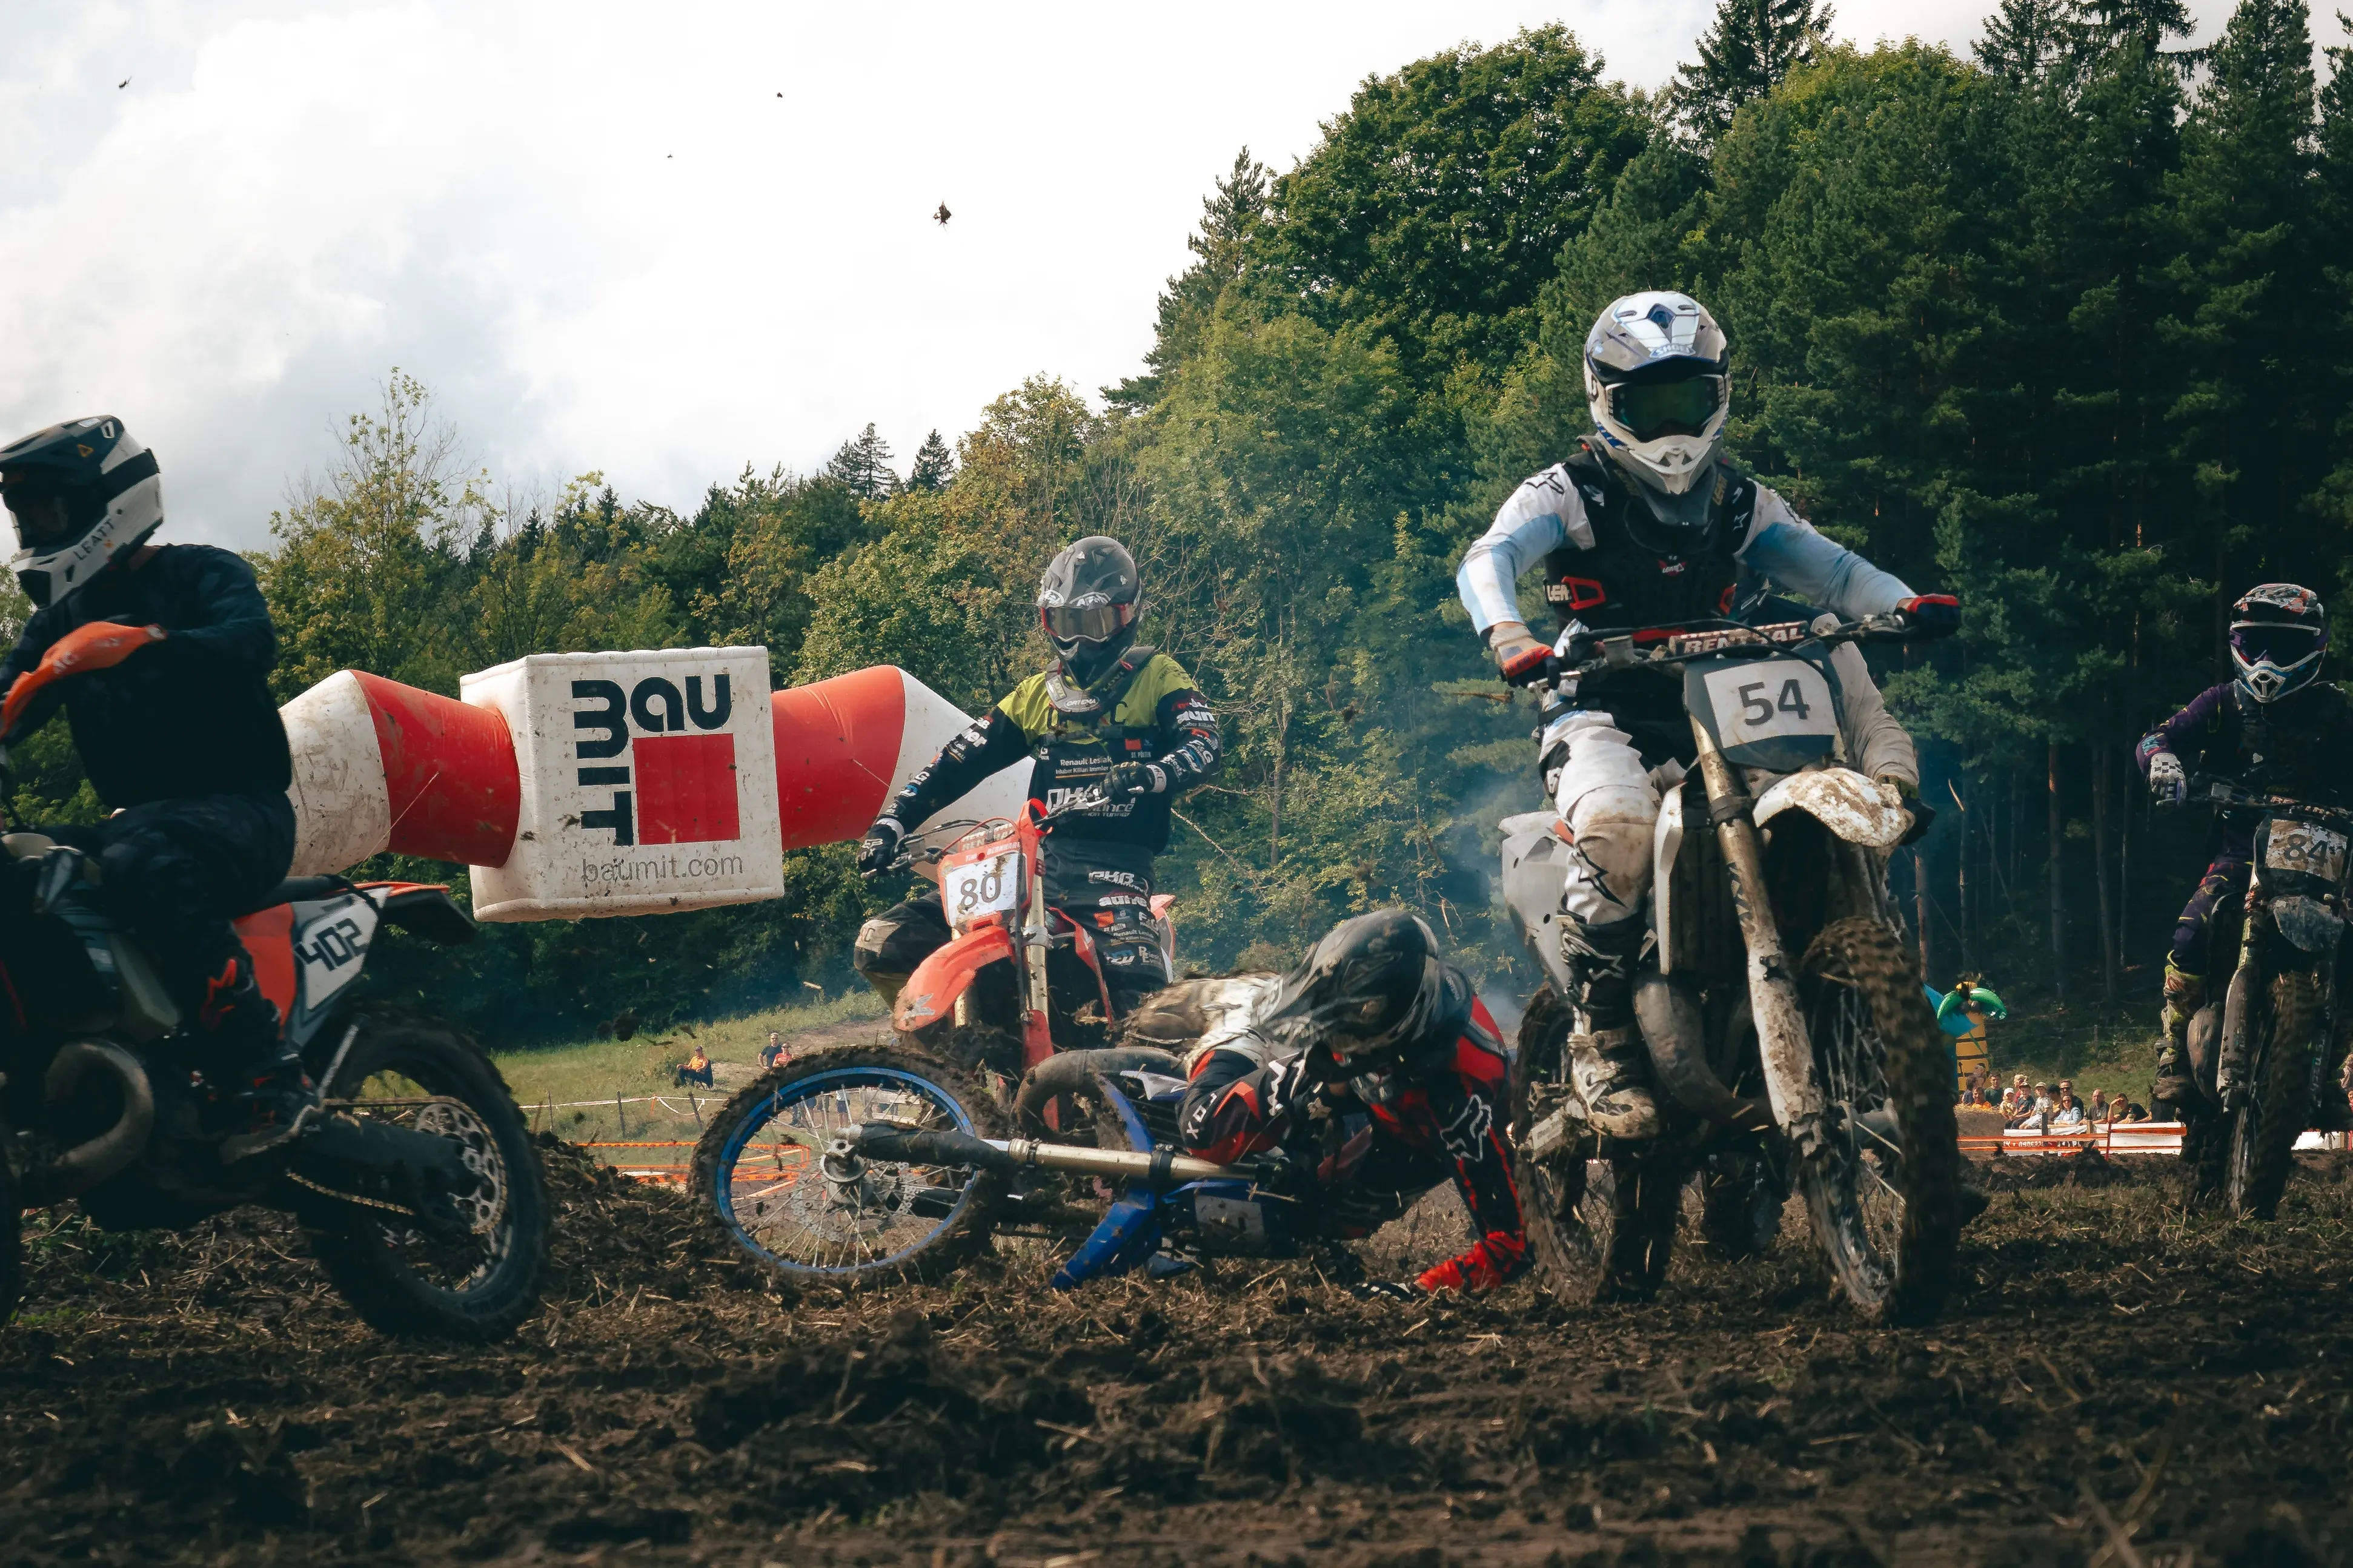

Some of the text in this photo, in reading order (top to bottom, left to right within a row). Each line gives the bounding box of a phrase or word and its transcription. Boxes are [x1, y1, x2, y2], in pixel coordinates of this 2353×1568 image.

[73, 518, 114, 561] LEATT
[1738, 678, 1811, 726] 54
[1060, 758, 1088, 766] Renault
[582, 854, 744, 884] baumit.com
[2285, 833, 2329, 868] 84
[960, 872, 1001, 909] 80
[294, 917, 369, 971] 402
